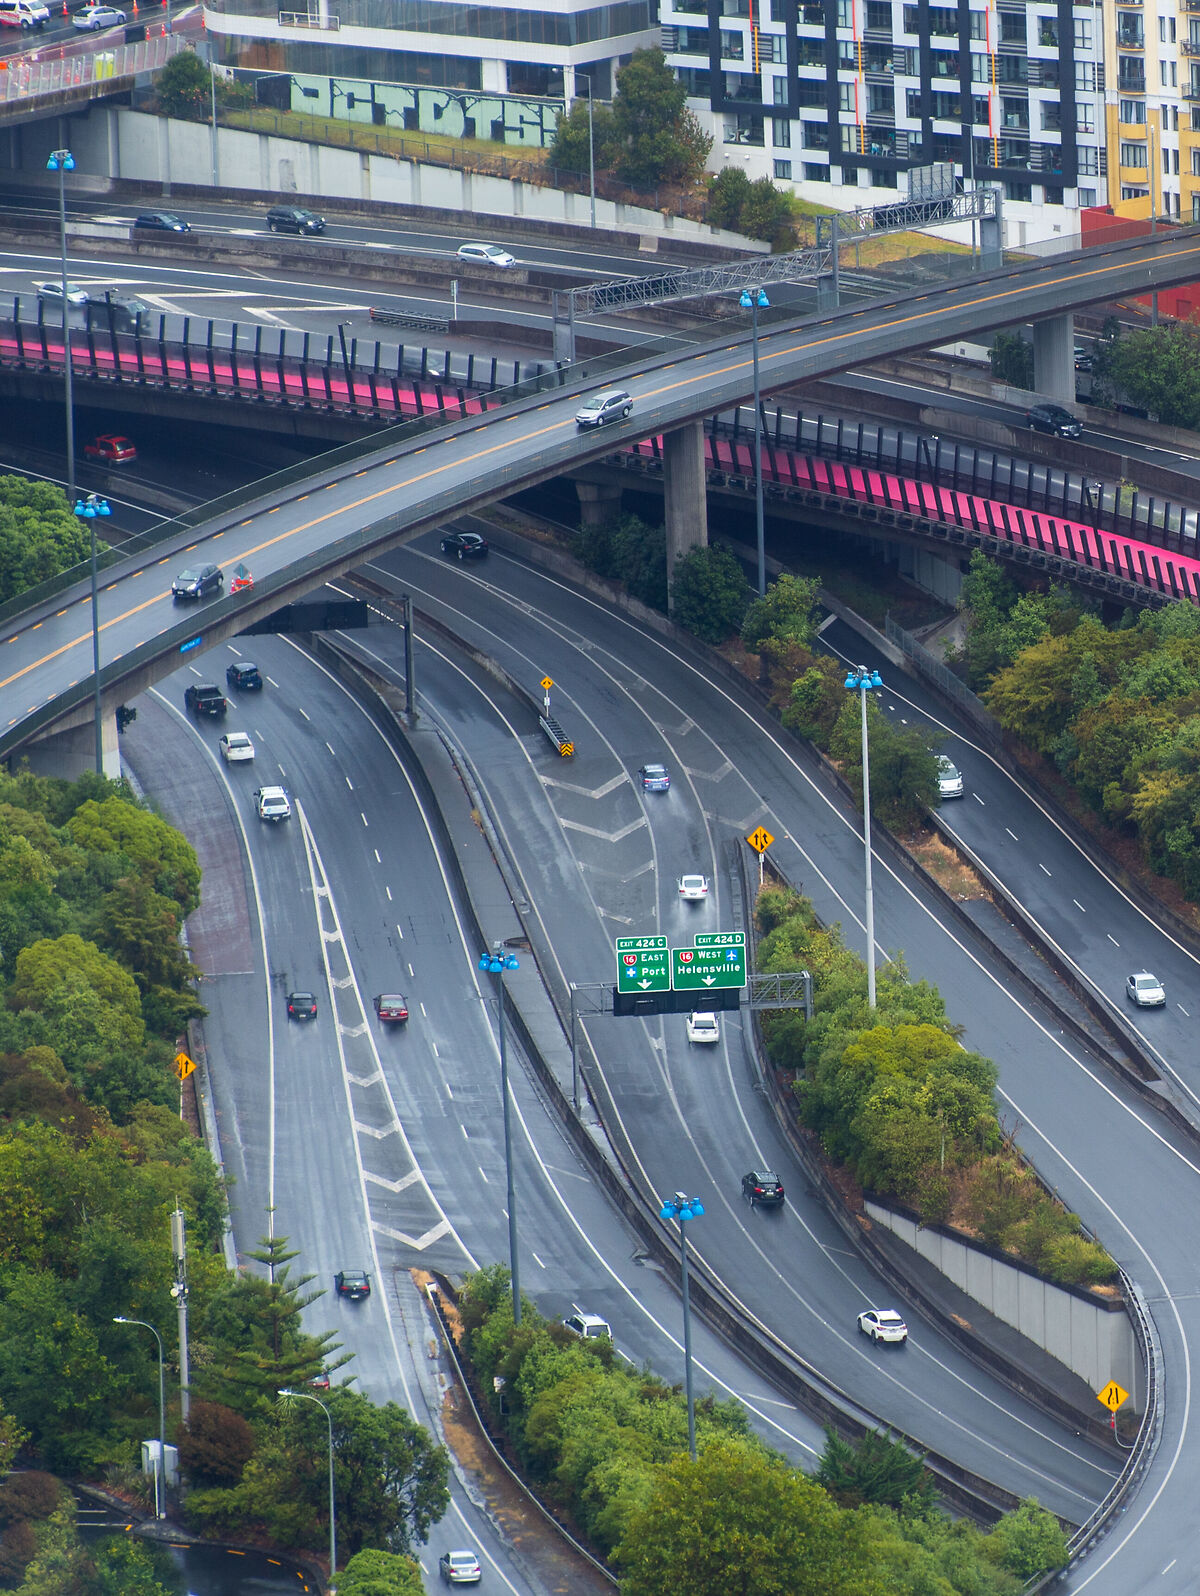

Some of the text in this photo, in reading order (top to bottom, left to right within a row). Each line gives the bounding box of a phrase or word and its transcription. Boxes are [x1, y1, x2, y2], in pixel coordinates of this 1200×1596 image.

[636, 939, 655, 947] 424
[714, 935, 733, 944] 424
[735, 935, 742, 943] D
[641, 953, 664, 962] EAST
[698, 950, 722, 959] WEST
[641, 966, 666, 976] Port
[677, 963, 741, 975] Helensville
